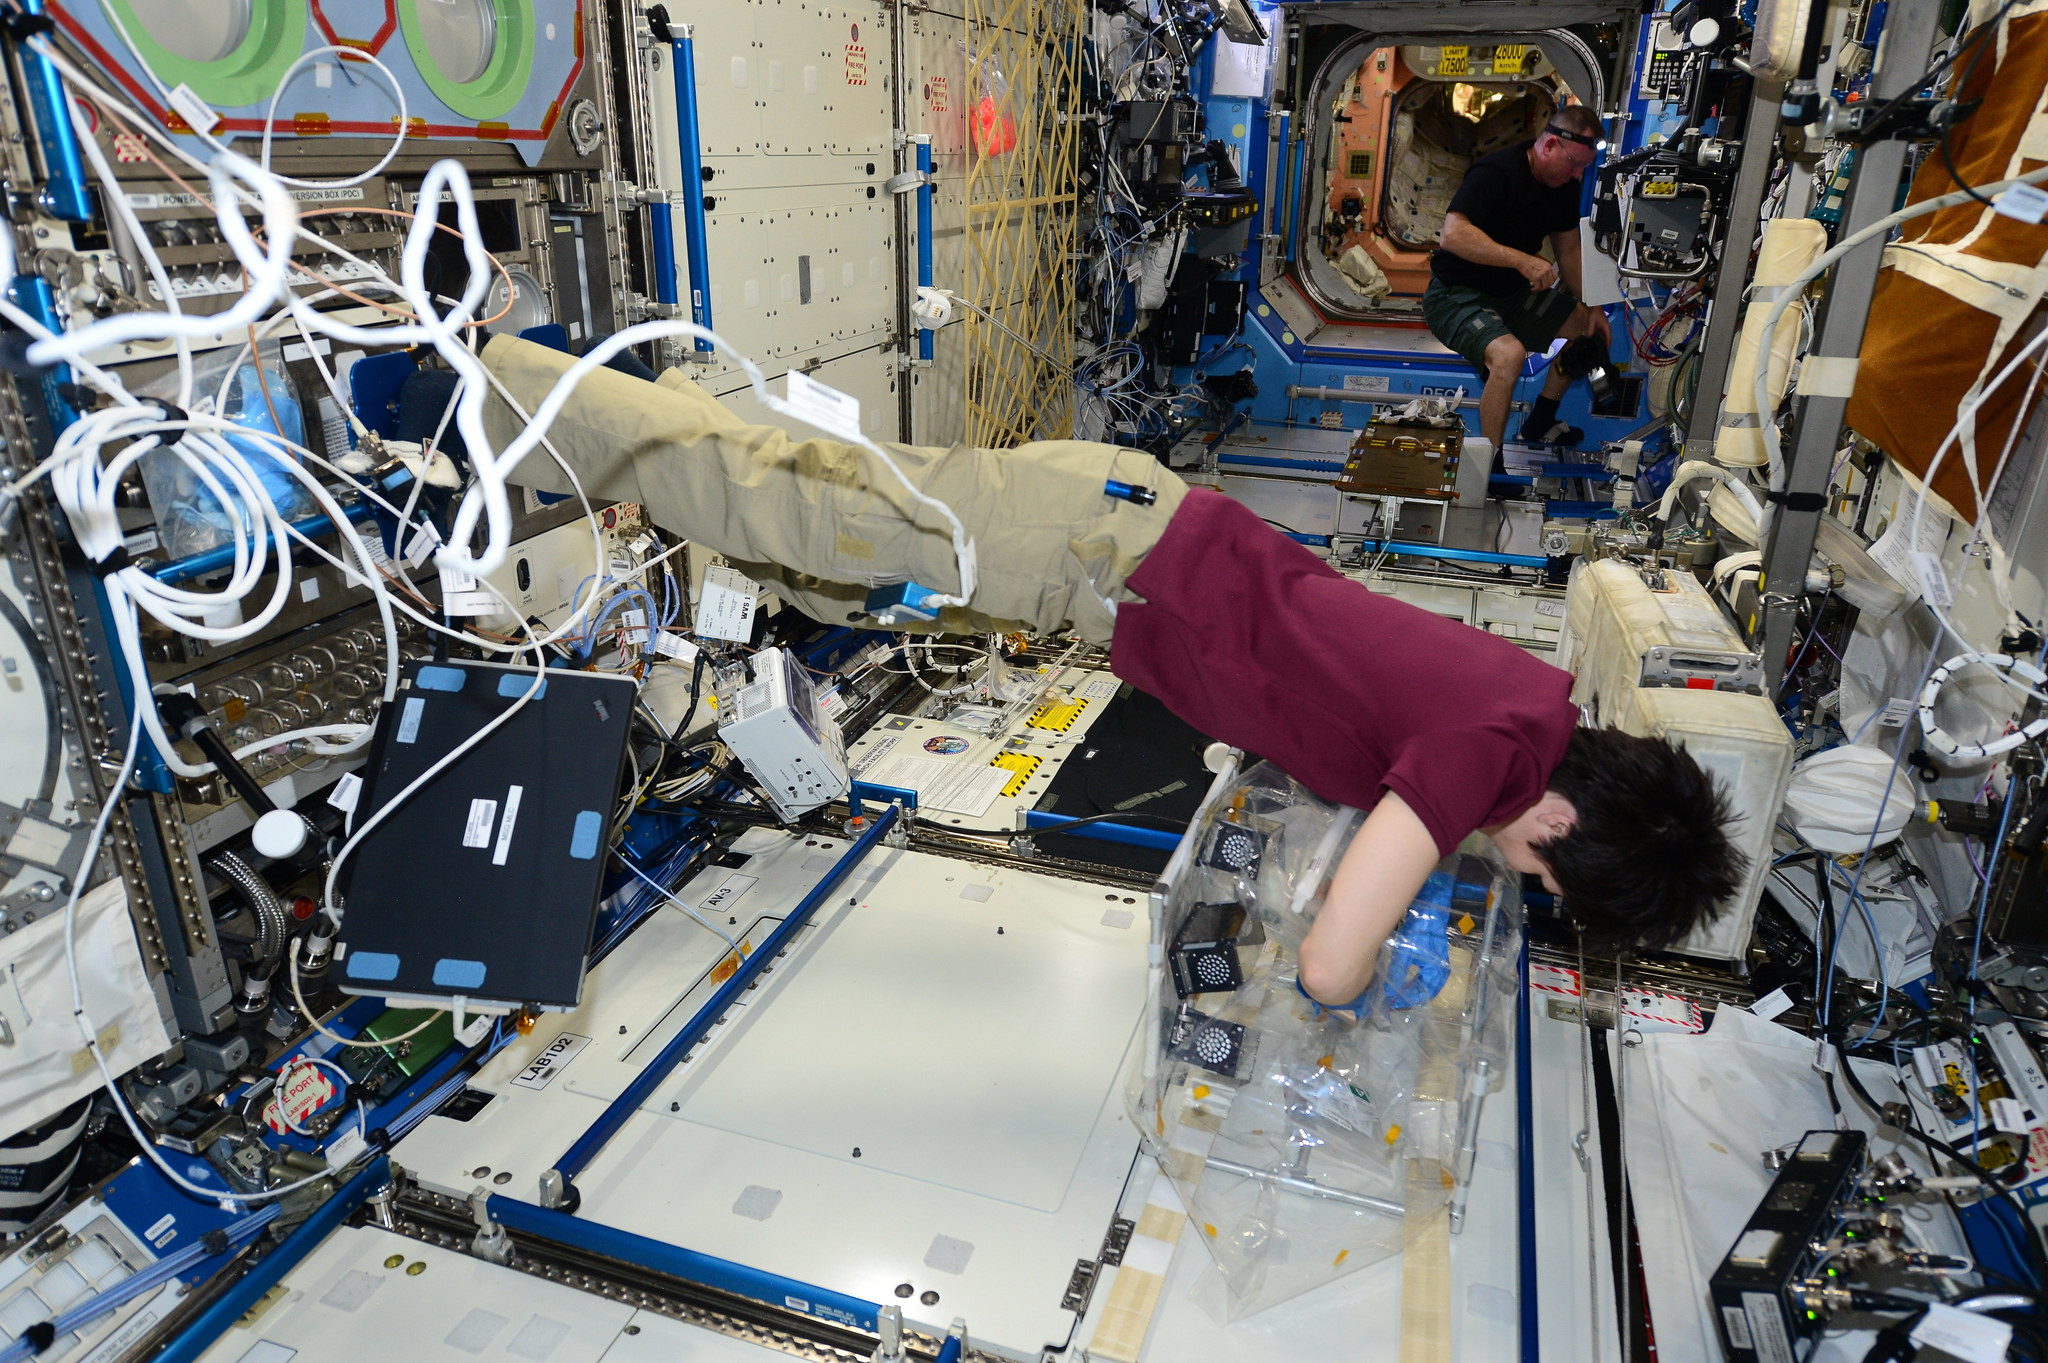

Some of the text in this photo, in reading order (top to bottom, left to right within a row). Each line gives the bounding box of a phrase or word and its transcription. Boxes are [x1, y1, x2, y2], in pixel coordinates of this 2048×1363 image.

[1497, 45, 1522, 59] 28000
[1441, 58, 1466, 72] 17500
[163, 194, 196, 204] POWER
[324, 191, 339, 199] BOX
[341, 190, 359, 198] (PDC)
[741, 602, 750, 620] WVS
[708, 889, 731, 905] AV-3
[521, 1038, 573, 1081] LAB1D2
[268, 1075, 315, 1114] FIE PORT
